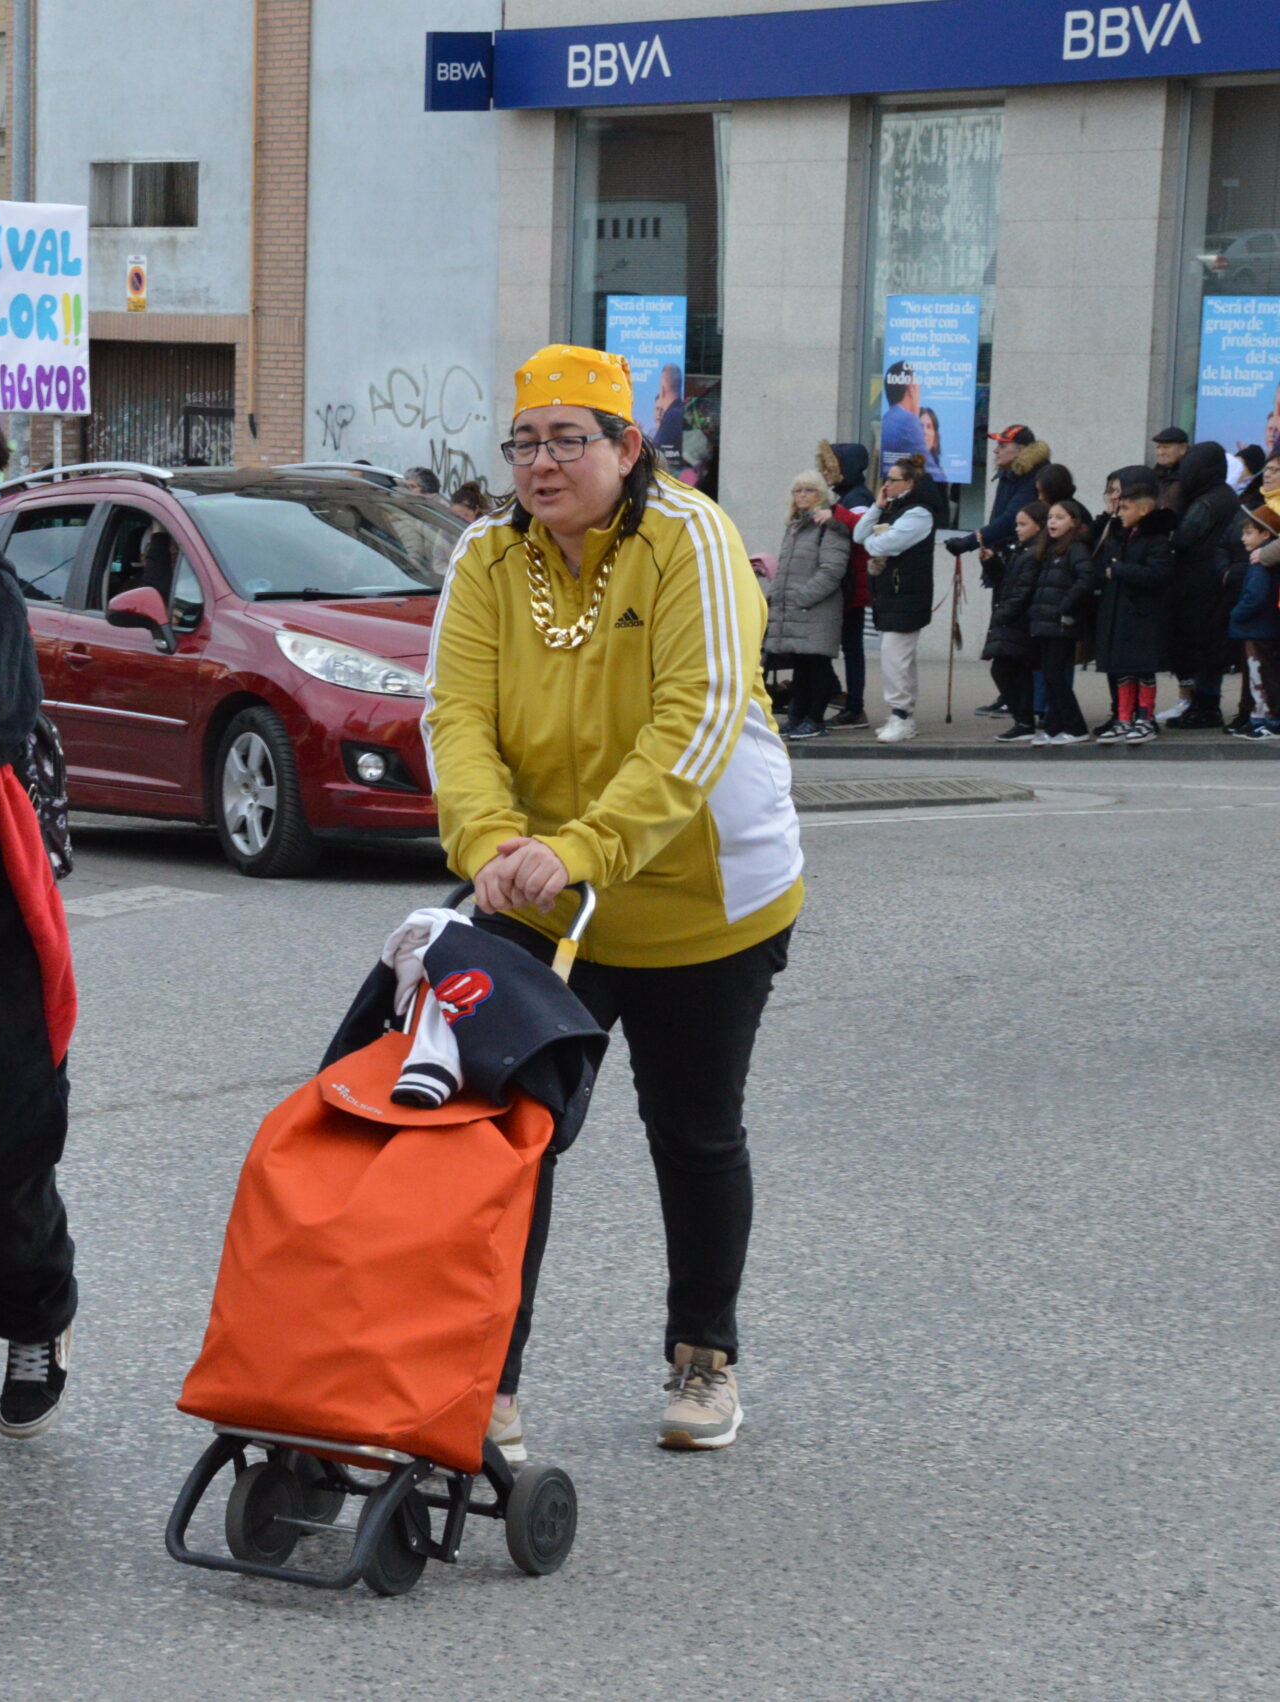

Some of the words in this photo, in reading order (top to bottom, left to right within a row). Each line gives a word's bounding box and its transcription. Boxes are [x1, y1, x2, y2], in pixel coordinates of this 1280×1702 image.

[1062, 0, 1202, 60] BBVA
[567, 34, 672, 88] BBVA
[437, 61, 486, 81] BBVA
[935, 302, 961, 314] trata
[962, 301, 976, 314] de
[889, 316, 937, 331] competir
[938, 318, 959, 329] con
[1206, 319, 1245, 334] grupo
[1247, 316, 1264, 331] de
[901, 344, 926, 356] trata
[927, 343, 941, 357] de
[1245, 350, 1266, 364] del
[902, 359, 951, 374] competir
[1202, 365, 1218, 380] de
[1220, 366, 1232, 380] la
[1234, 366, 1274, 381] banca
[887, 372, 912, 384] todo
[0, 363, 86, 411] HUMOR
